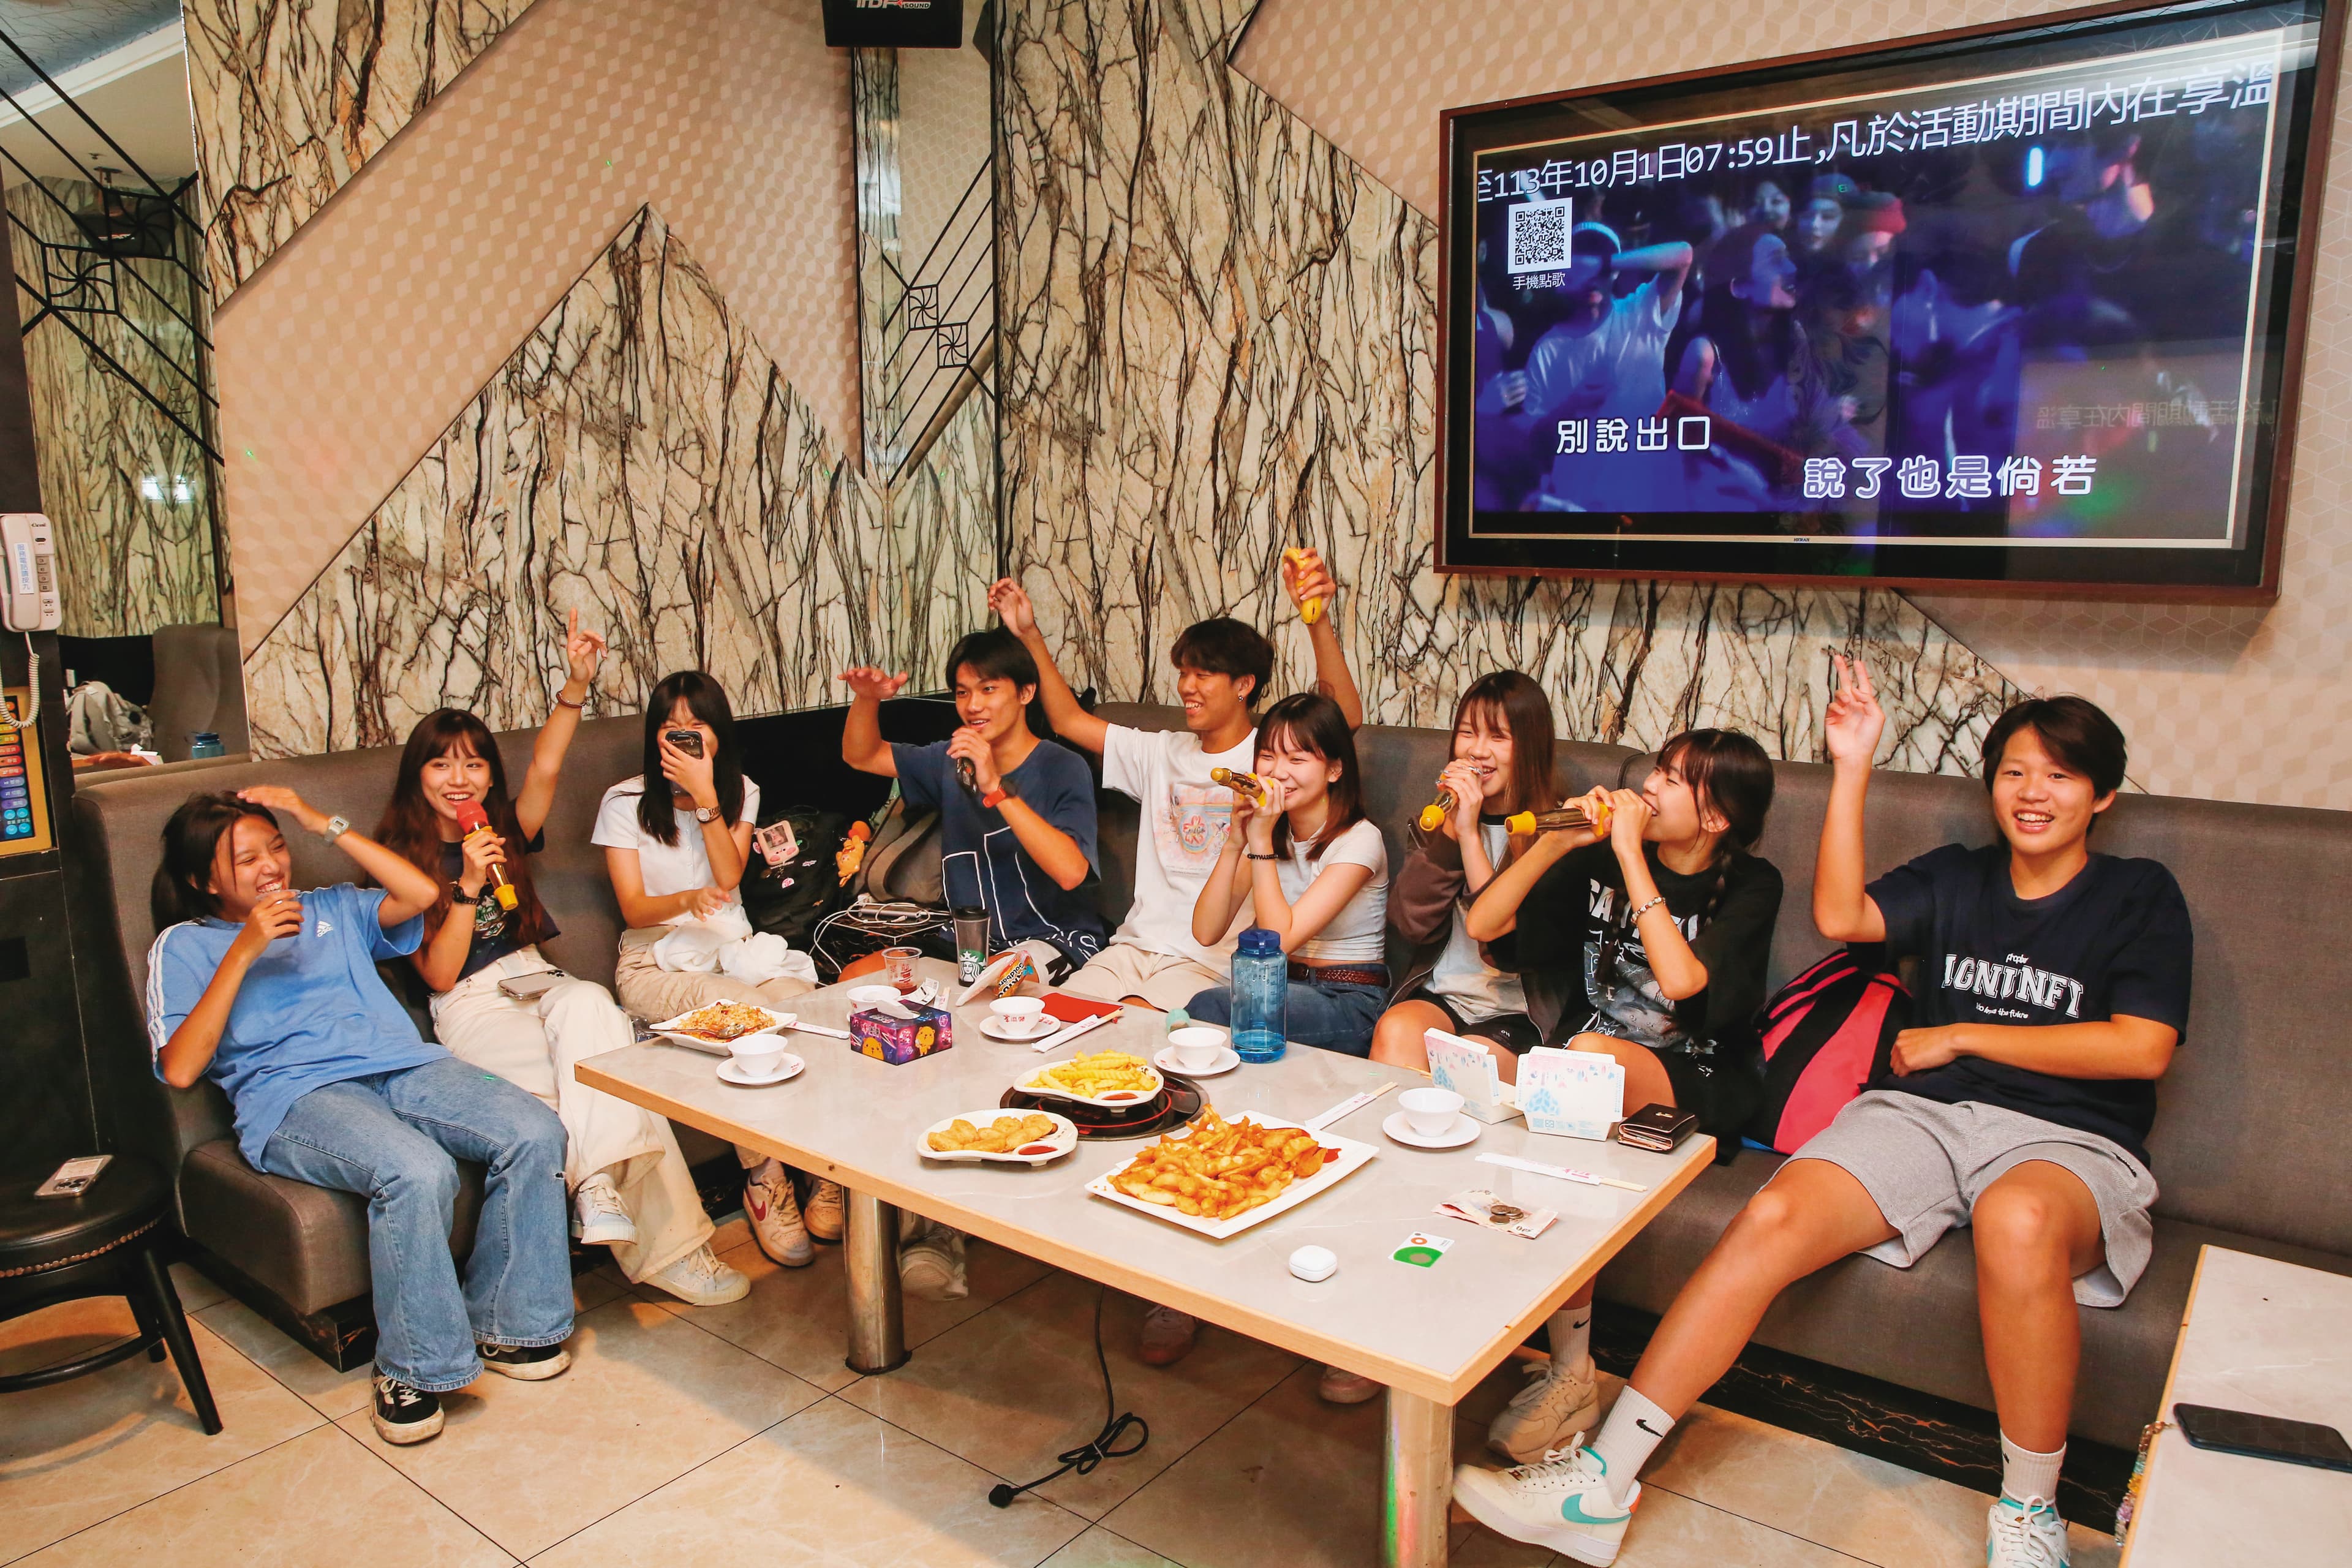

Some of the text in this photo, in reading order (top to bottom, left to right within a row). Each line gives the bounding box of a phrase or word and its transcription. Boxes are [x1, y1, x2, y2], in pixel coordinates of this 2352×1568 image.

[1512, 273, 1566, 290] 手機點歌
[1556, 416, 1711, 454] 別說出口
[1803, 454, 2097, 499] 說了也是倘若
